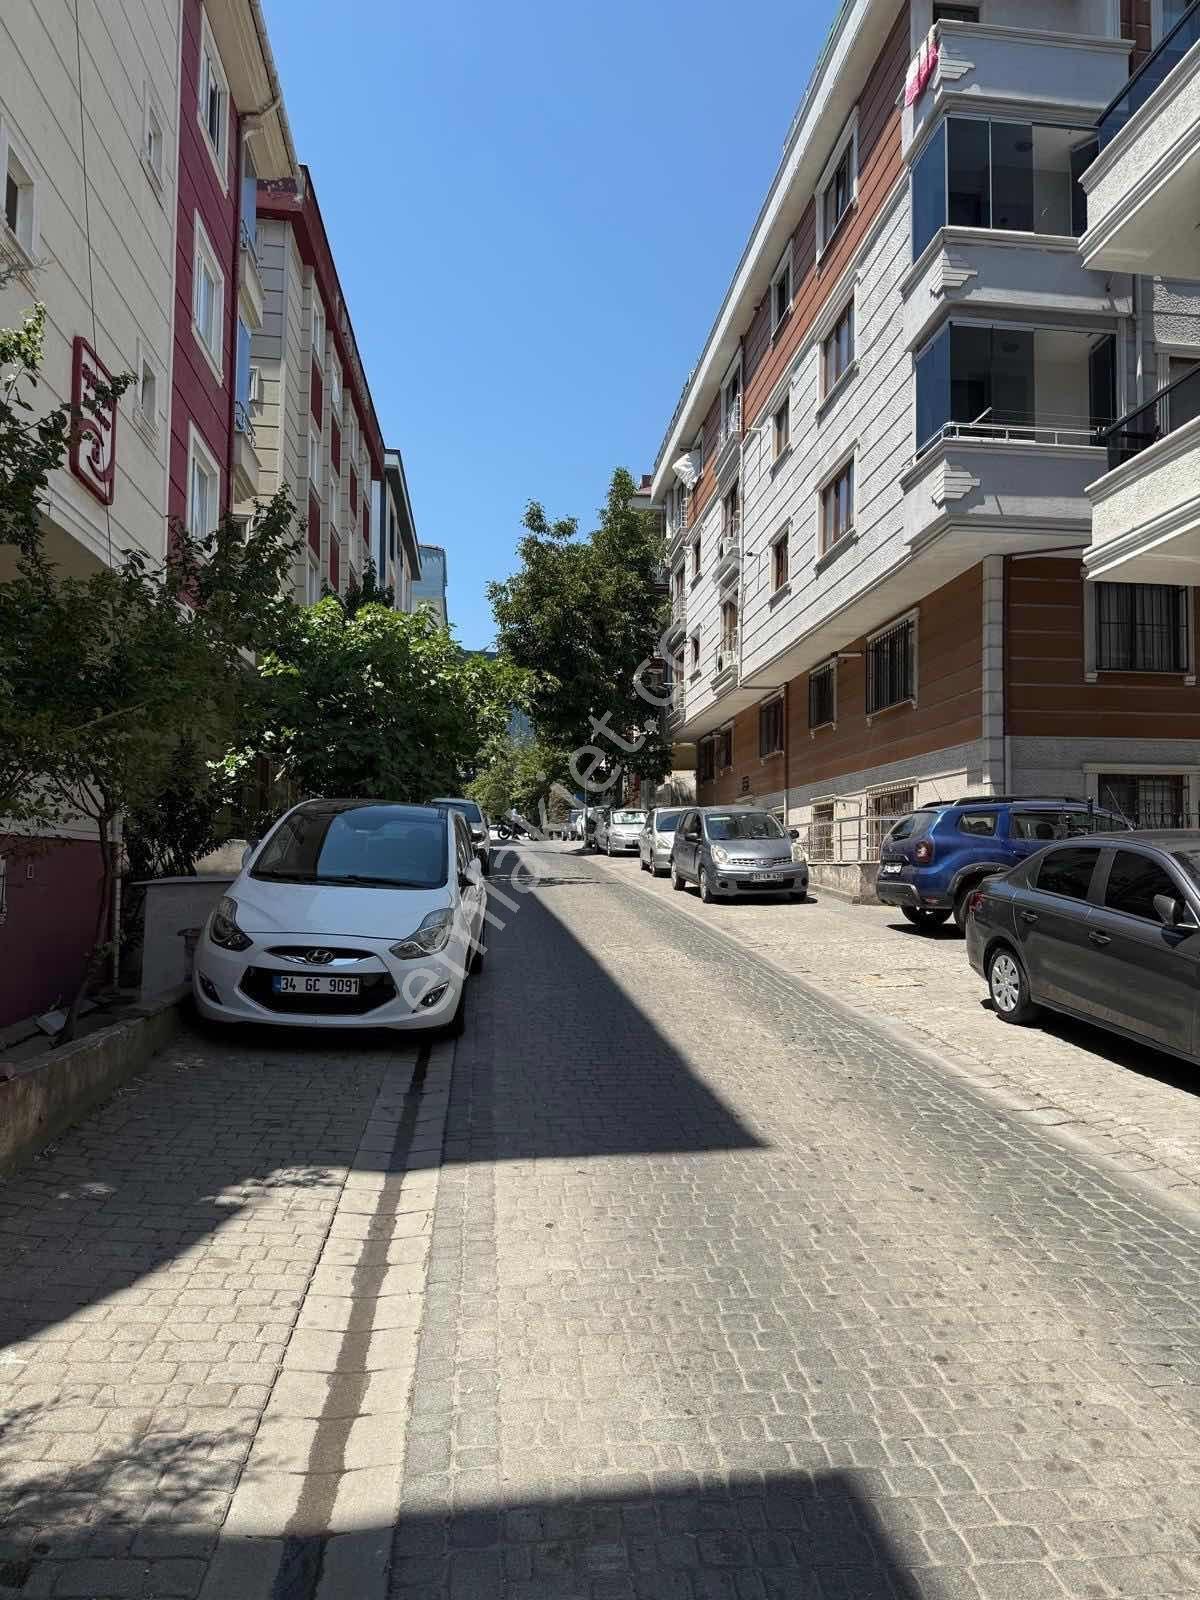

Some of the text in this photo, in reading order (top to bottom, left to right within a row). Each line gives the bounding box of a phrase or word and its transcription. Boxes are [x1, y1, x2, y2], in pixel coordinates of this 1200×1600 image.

[282, 977, 358, 993] 34 GC 9091
